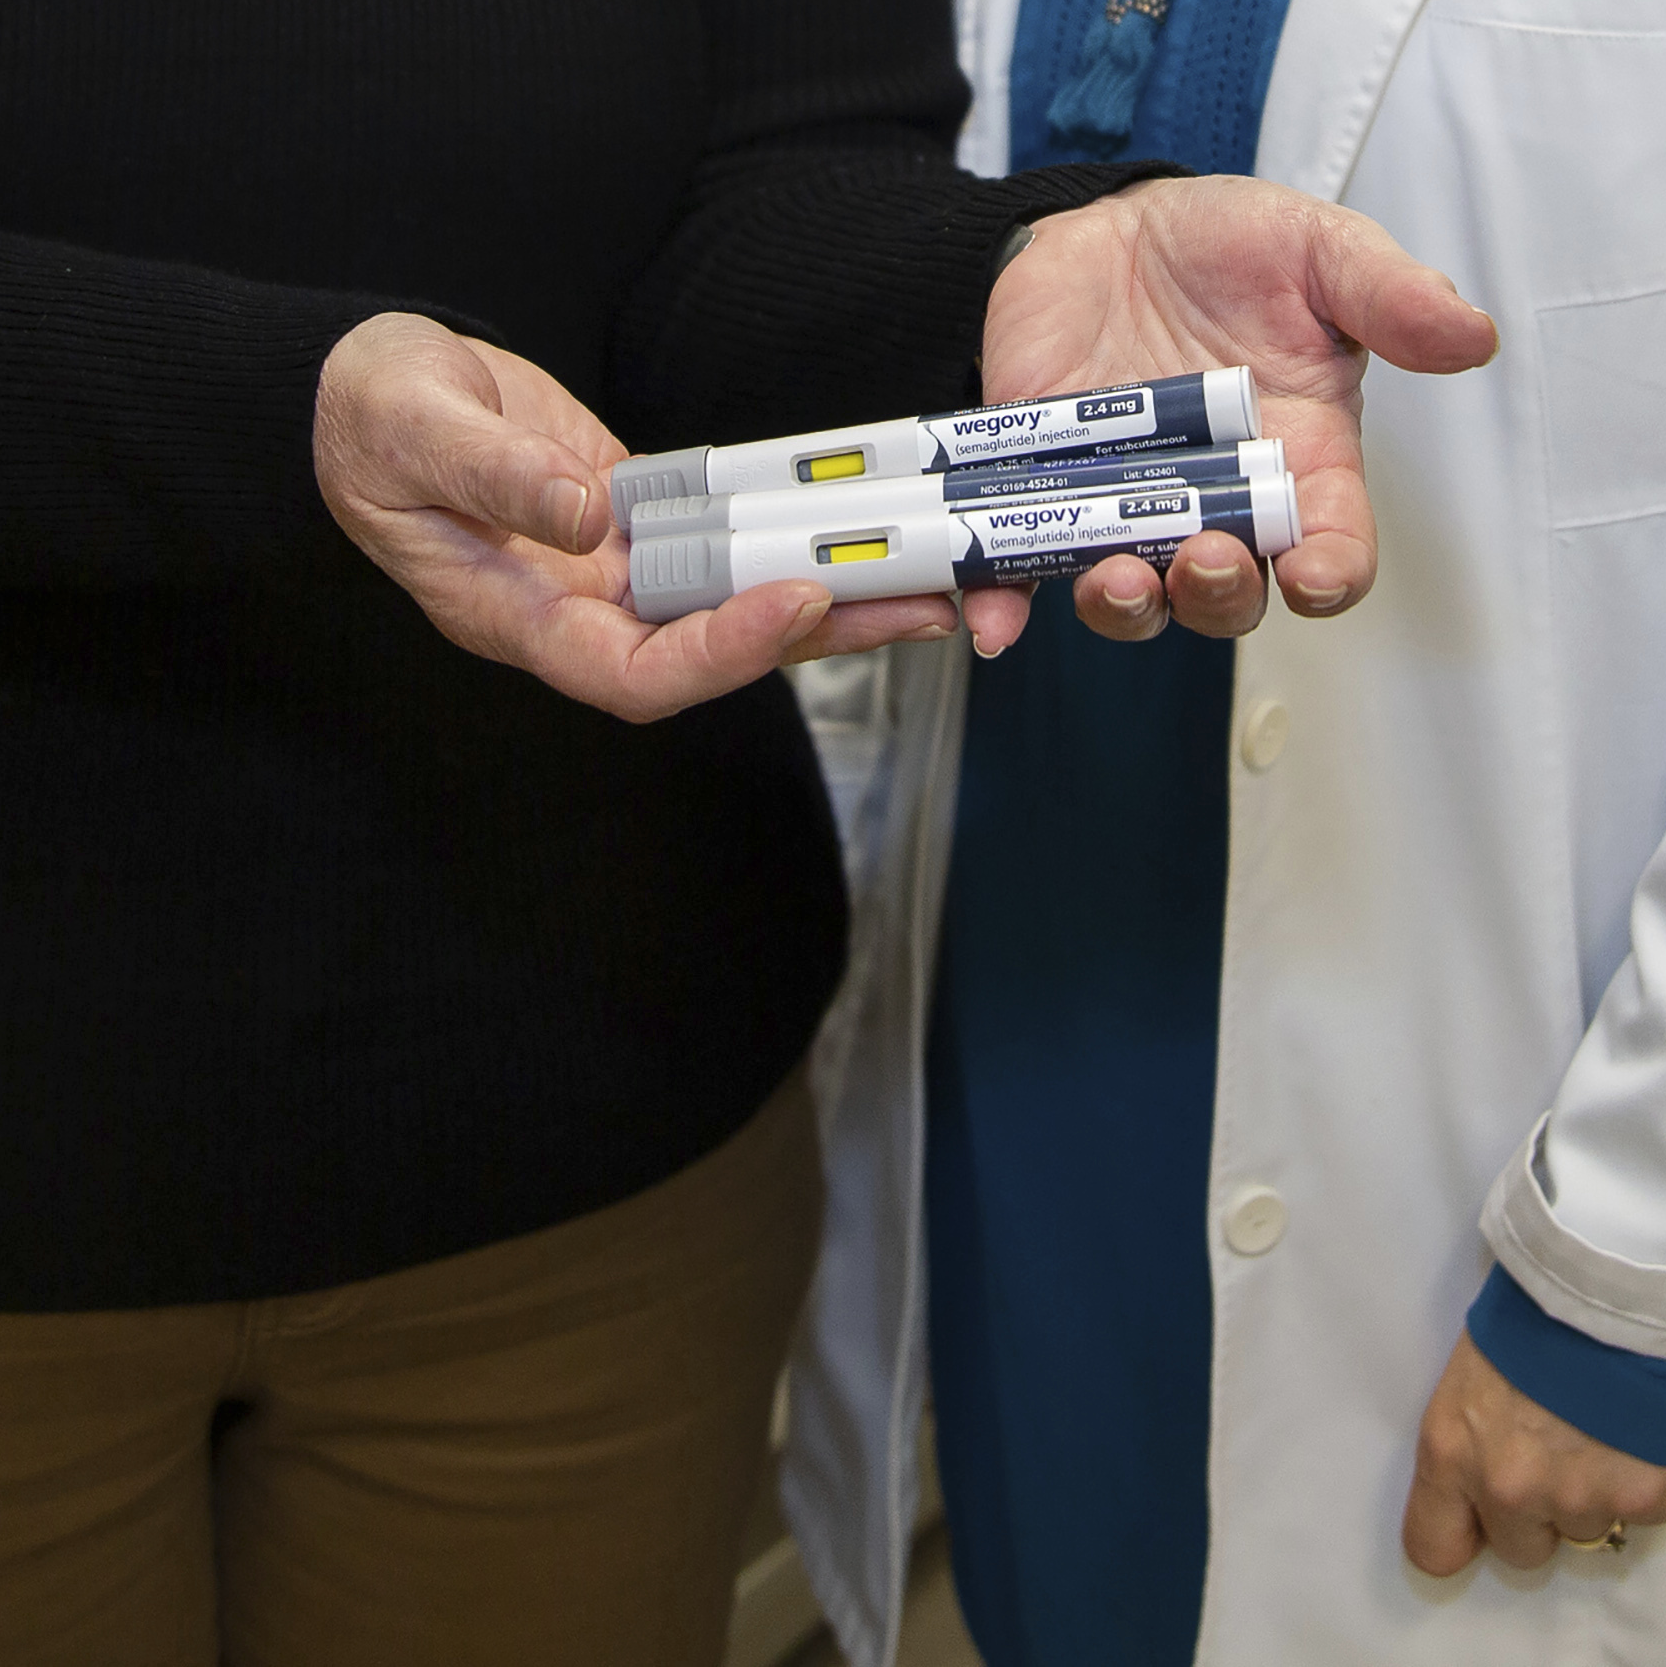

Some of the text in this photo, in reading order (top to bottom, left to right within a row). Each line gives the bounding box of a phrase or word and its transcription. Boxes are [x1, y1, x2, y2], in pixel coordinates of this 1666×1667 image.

[1083, 402, 1108, 417] 2.4
[1111, 399, 1136, 413] mg
[955, 426, 1090, 457] (semaglutide) injection
[1095, 434, 1188, 455] For subcutaneous
[980, 466, 1177, 495] NDC 0169-4524-01 List: 452401
[1126, 500, 1152, 514] 2.4
[1155, 497, 1182, 512] mg
[990, 524, 1132, 550] (semaglutide) injection
[1136, 544, 1155, 555] For
[993, 552, 1075, 571] 2.4 mg/0.75 mL
